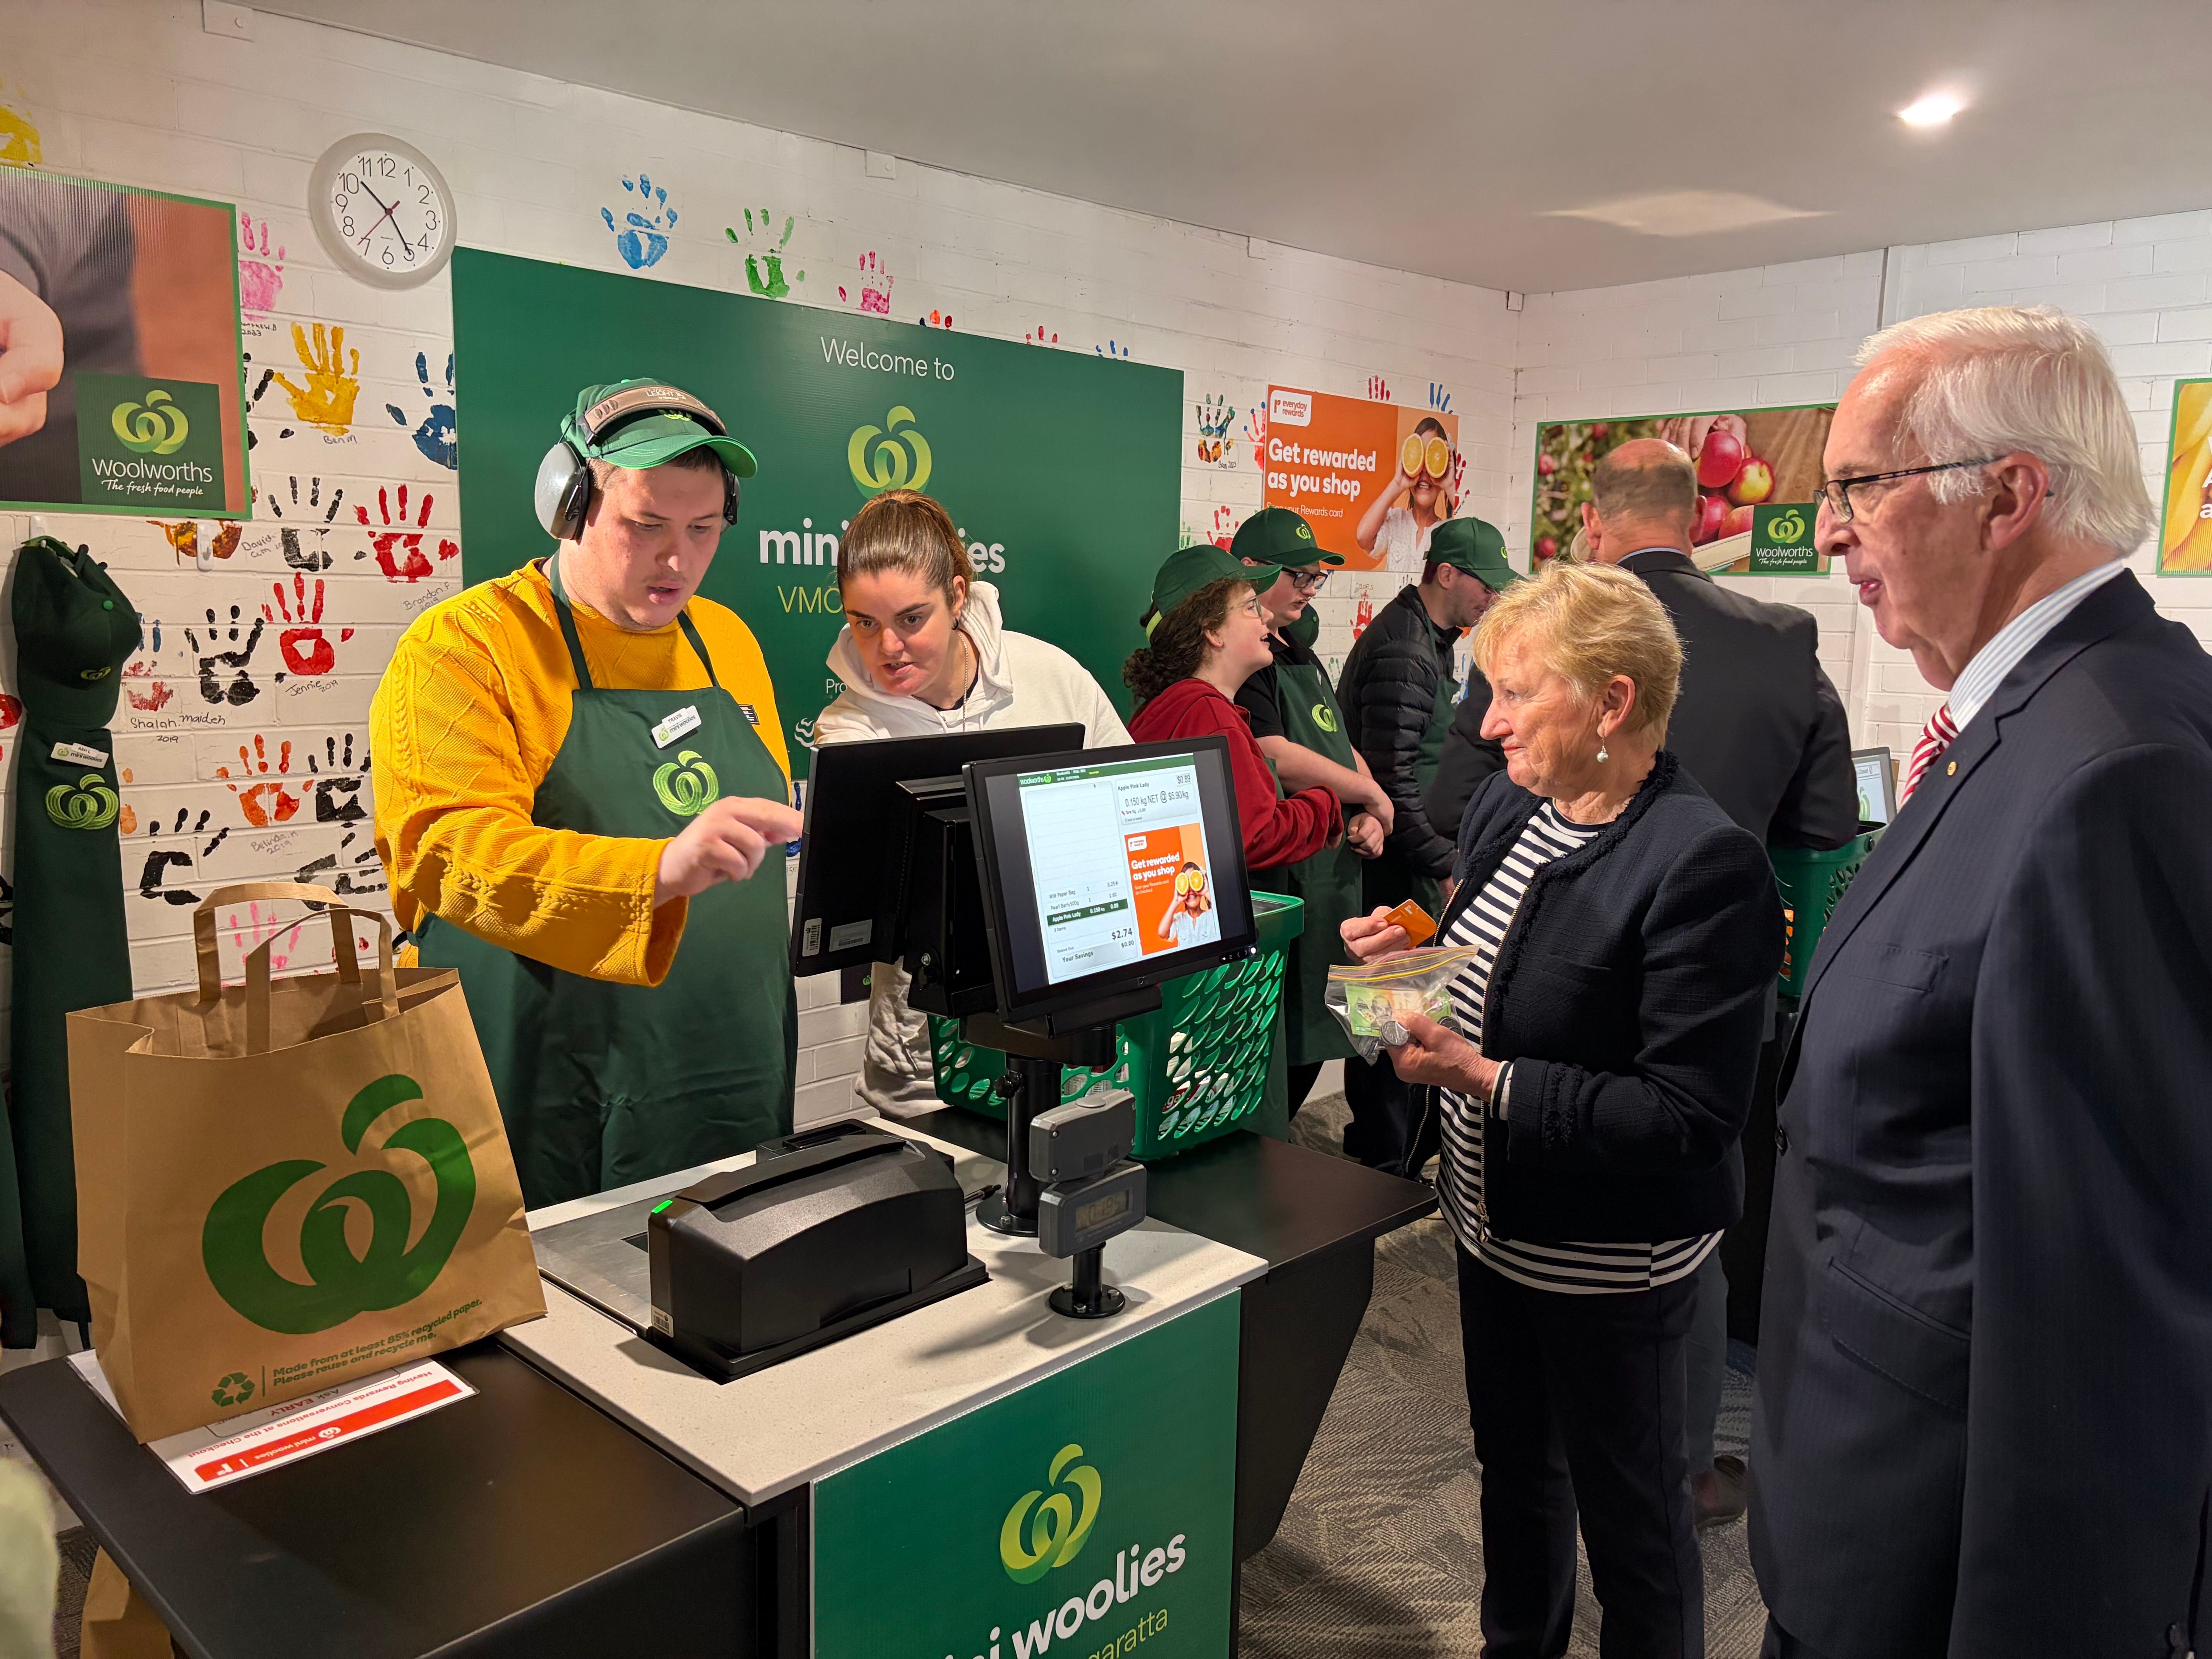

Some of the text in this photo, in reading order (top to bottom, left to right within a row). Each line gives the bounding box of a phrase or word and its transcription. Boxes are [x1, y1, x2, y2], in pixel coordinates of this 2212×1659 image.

[358, 156, 371, 177] 11
[377, 156, 395, 178] 12
[339, 173, 359, 194] 10
[404, 168, 410, 187] 1
[335, 194, 348, 213] 9
[418, 185, 429, 204] 2
[343, 216, 355, 237] 8
[426, 210, 436, 230] 3
[360, 237, 371, 256] 7
[404, 242, 415, 261] 5
[417, 233, 428, 252] 4
[382, 246, 394, 264] 6
[820, 336, 955, 381] Welcome to
[1282, 399, 1307, 411] everyday
[1282, 408, 1304, 417] rewards
[1269, 438, 1376, 472] Get rewarded
[92, 458, 213, 483] Woolworths
[101, 479, 204, 498] The fresh food people
[1267, 471, 1360, 502] as you shop
[1300, 505, 1328, 516] Rewards
[1329, 508, 1343, 517] card
[1756, 546, 1813, 557] Woolworths
[403, 587, 443, 610] Brandon
[777, 586, 843, 614] VMC
[285, 680, 338, 696] Jennie 2019
[826, 678, 848, 694] Pro
[156, 735, 179, 743] 2019
[1177, 775, 1191, 785] $0.89
[1125, 797, 1139, 807] 0.150
[1140, 797, 1147, 806] kg
[1147, 794, 1158, 804] NET
[1160, 791, 1167, 804] @
[1131, 851, 1180, 870] Get rewarded
[1133, 866, 1175, 881] as you shop
[1111, 927, 1133, 941] $2.74
[1121, 940, 1134, 948] $0.00
[1075, 951, 1094, 960] Savings
[273, 1298, 483, 1378] Made from at least 85% recycled paper.
[274, 1333, 437, 1386] Please reuse and recycle me.
[397, 1371, 433, 1385] Having
[353, 1383, 397, 1401] Rewards
[271, 1389, 339, 1416] Ask EARLY
[277, 1400, 352, 1427] Conversations
[244, 1431, 262, 1439] the
[188, 1437, 242, 1458] Checkout
[1012, 1534, 1187, 1659] woolies
